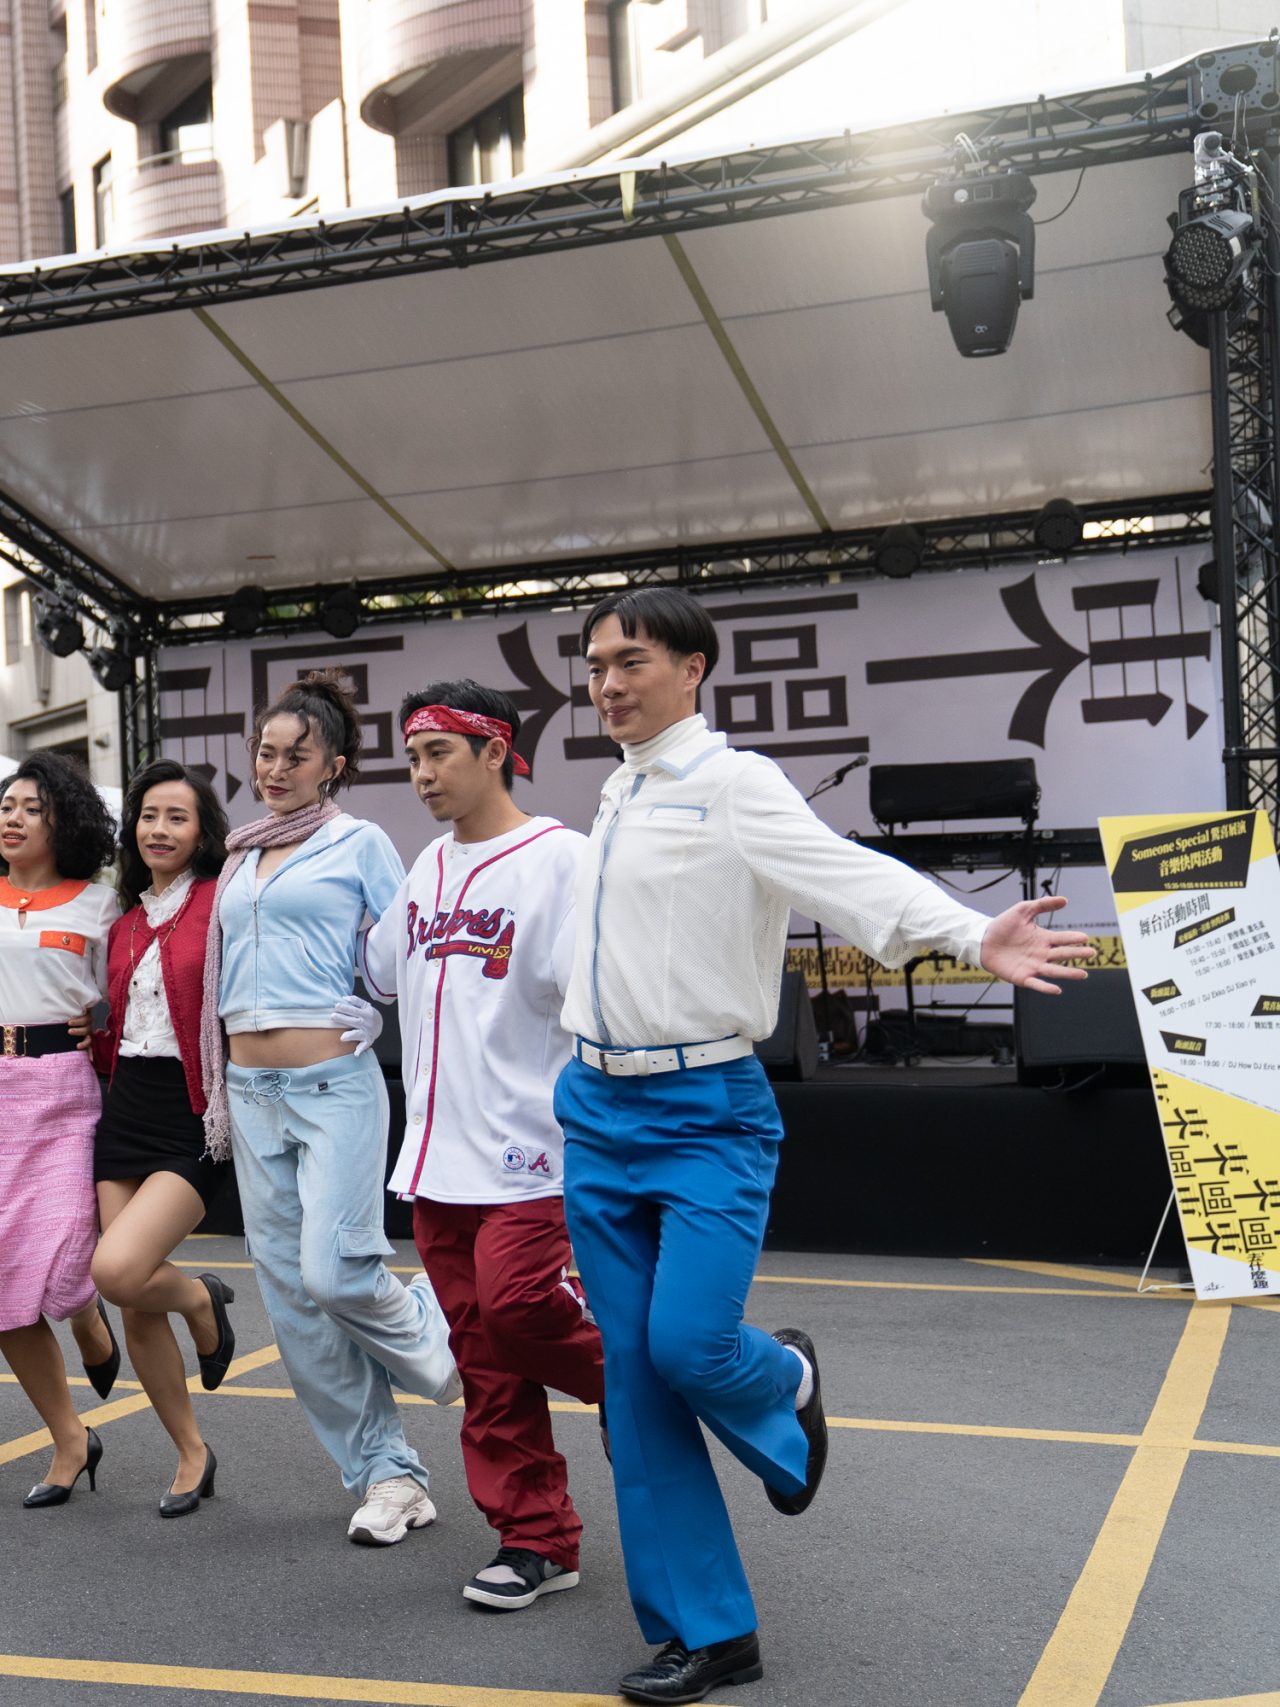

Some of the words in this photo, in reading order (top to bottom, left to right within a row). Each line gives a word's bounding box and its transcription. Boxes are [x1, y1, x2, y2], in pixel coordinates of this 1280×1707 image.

[1131, 842, 1175, 862] Someone
[1175, 829, 1209, 852] Special
[1159, 846, 1223, 878] 音樂快閃活動
[1139, 893, 1211, 938] 舞台活動時間
